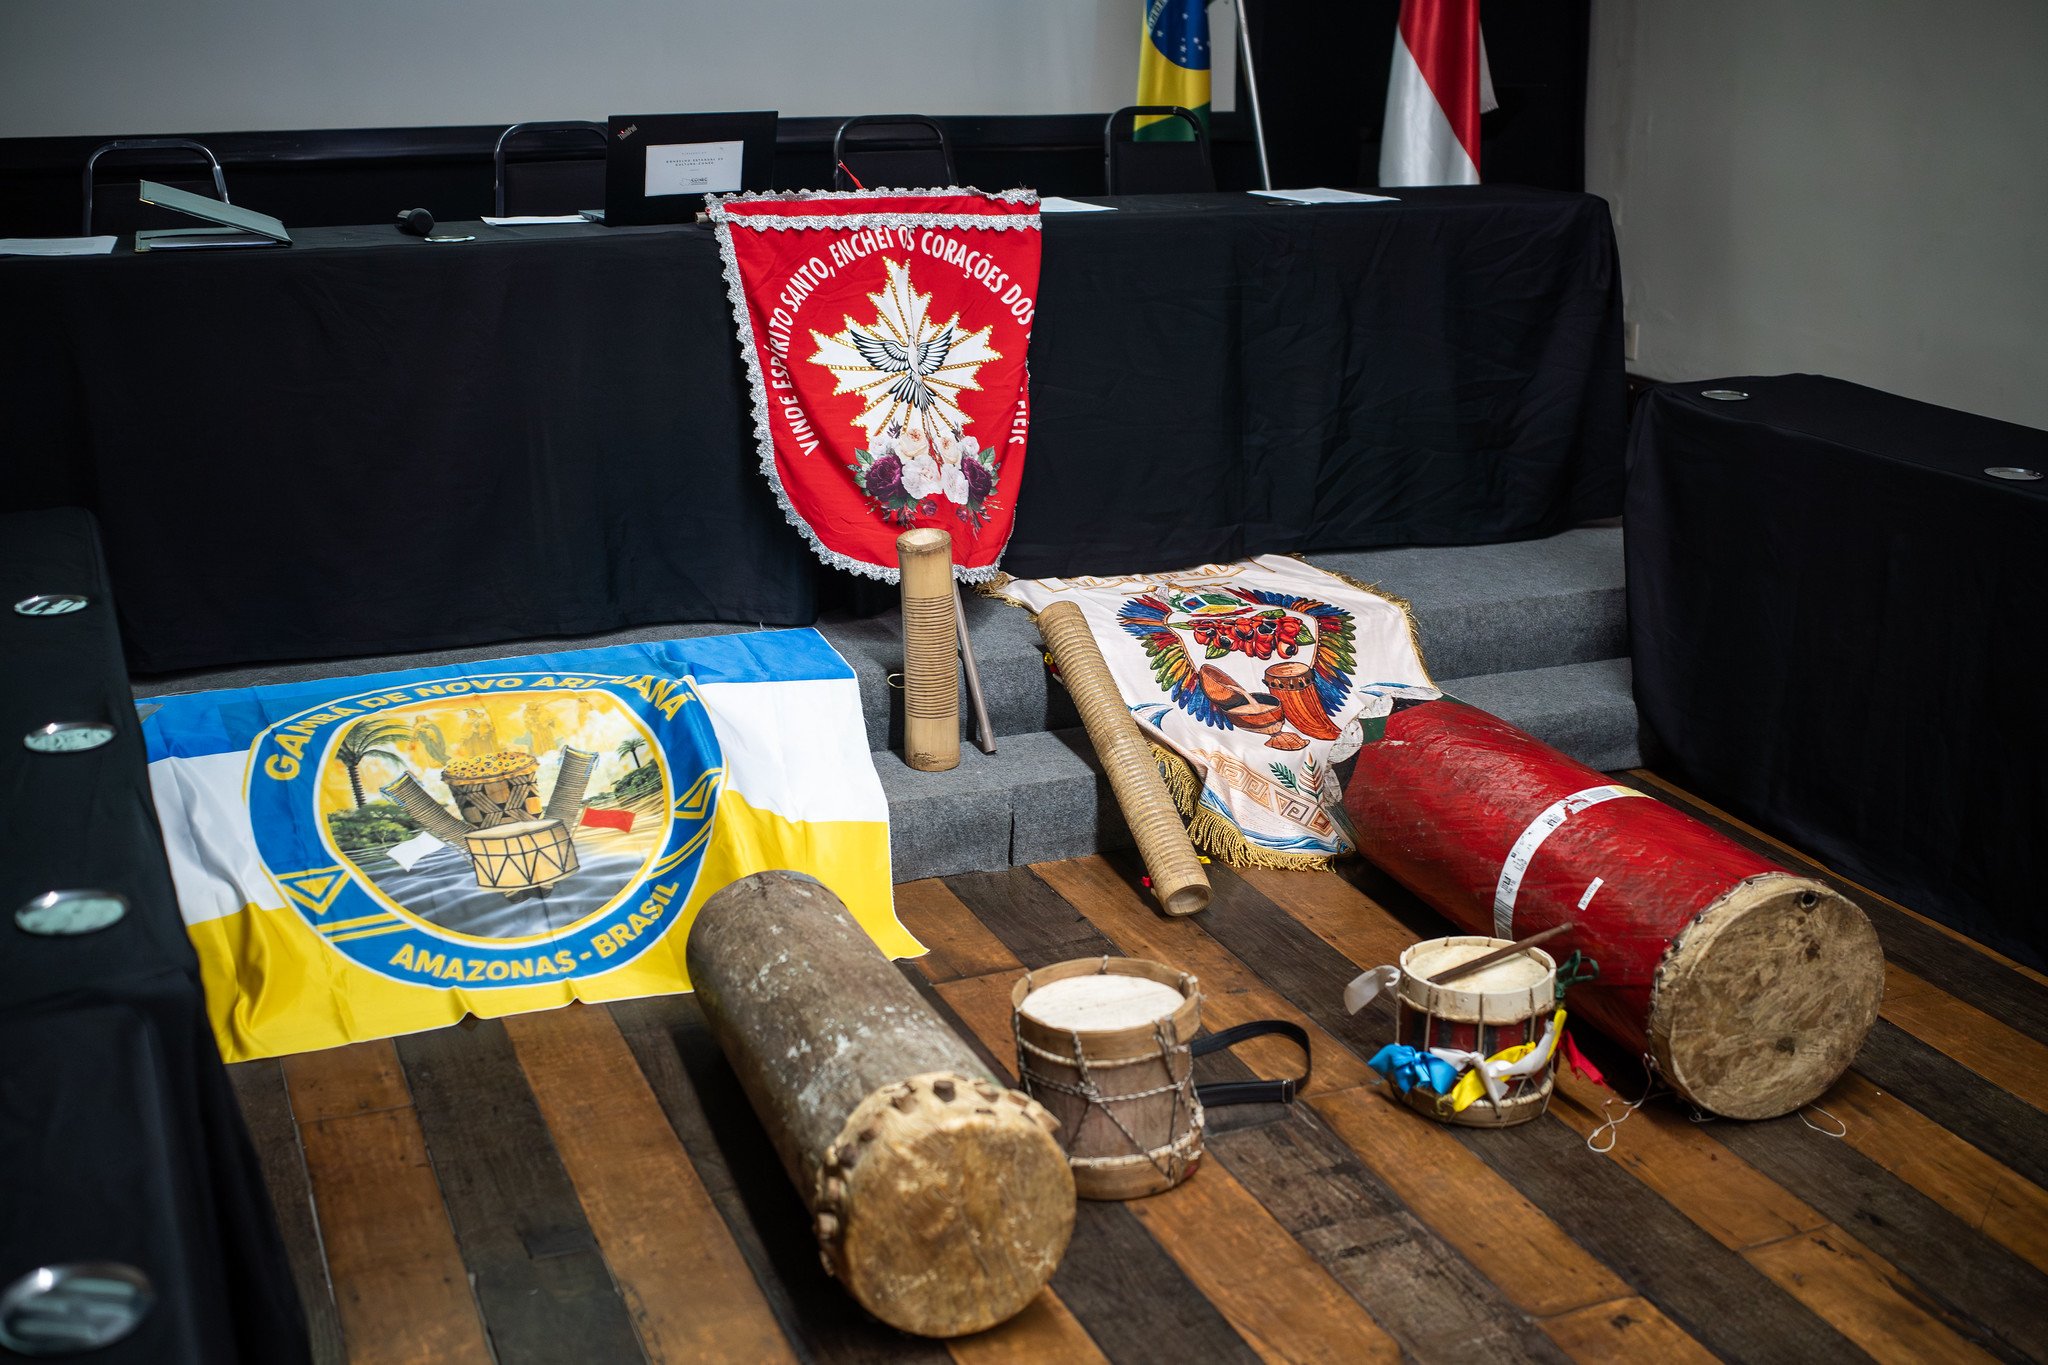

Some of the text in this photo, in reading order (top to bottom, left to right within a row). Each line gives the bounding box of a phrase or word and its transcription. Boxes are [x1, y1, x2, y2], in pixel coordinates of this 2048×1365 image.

[828, 227, 894, 268] ENCHEI
[898, 225, 915, 251] OS
[921, 231, 1010, 293] CORAÇÕES
[780, 257, 836, 313] SANTO,
[1000, 283, 1035, 325] DOS
[763, 307, 794, 390] ESPÍRITO
[779, 395, 820, 457] VINDE
[264, 705, 366, 781] GAMBÁ
[356, 691, 413, 709] DE
[414, 677, 524, 697] NOVO
[389, 943, 578, 982] AMAZONAS
[590, 881, 680, 959] BRASIL
